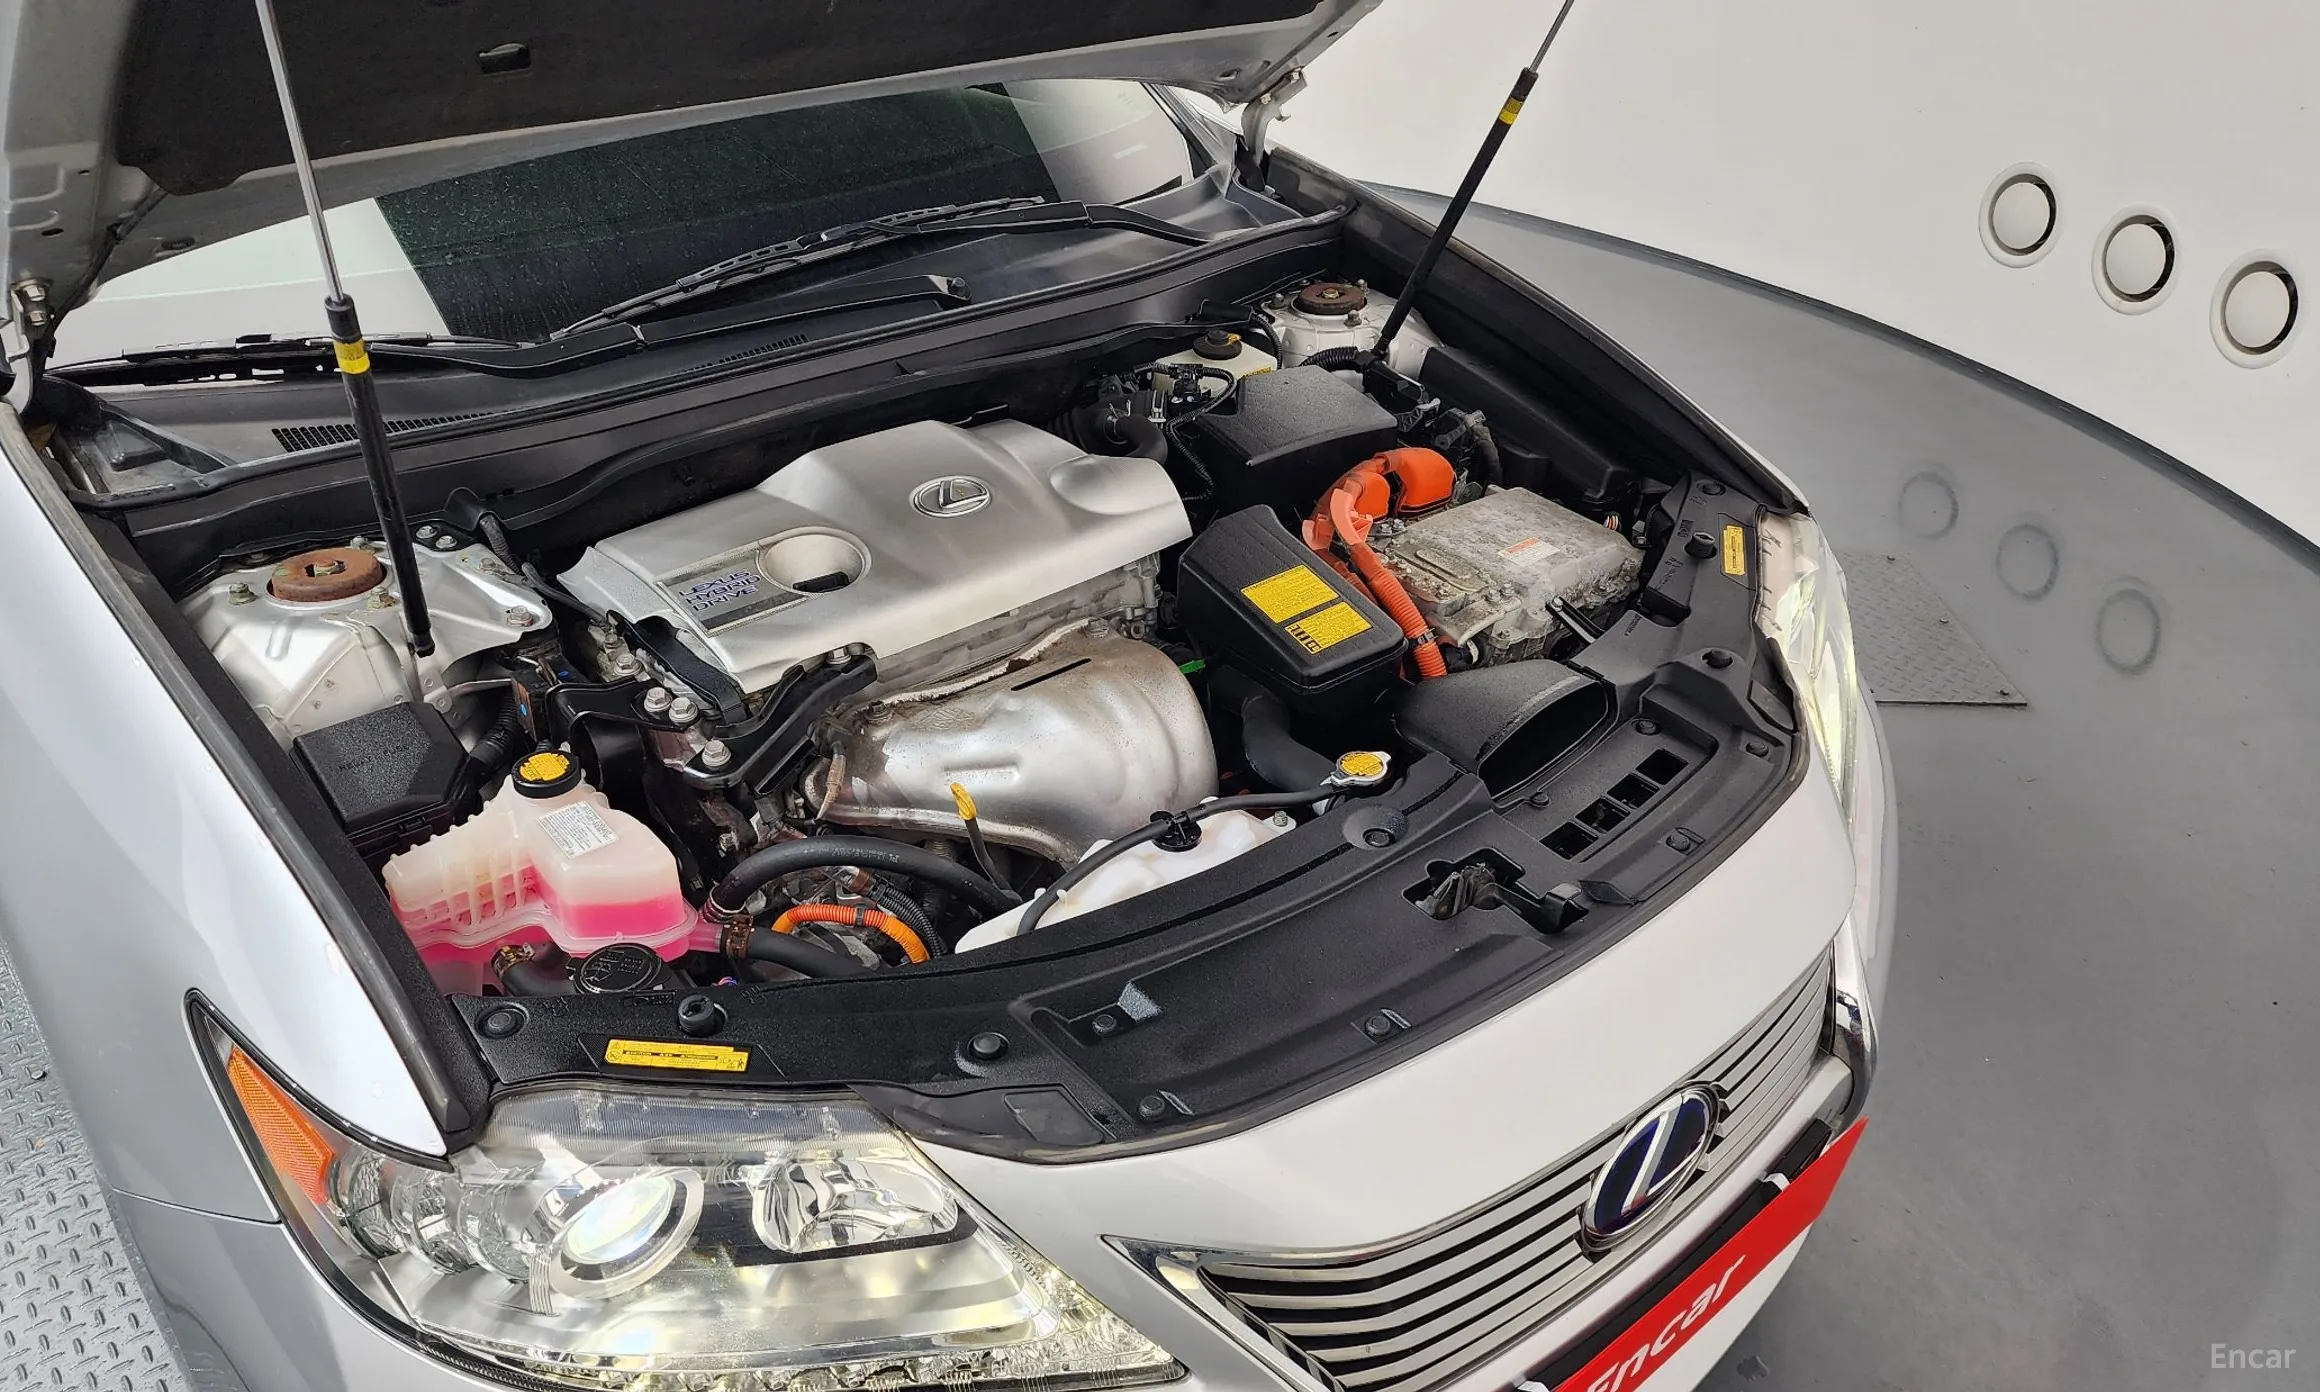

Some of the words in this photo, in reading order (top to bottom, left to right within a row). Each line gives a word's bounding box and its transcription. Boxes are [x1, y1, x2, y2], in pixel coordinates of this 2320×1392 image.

[679, 570, 750, 596] LEXUS
[686, 575, 761, 604] HYBRID
[693, 585, 758, 611] DRIVE
[1587, 1254, 1747, 1392] Encar
